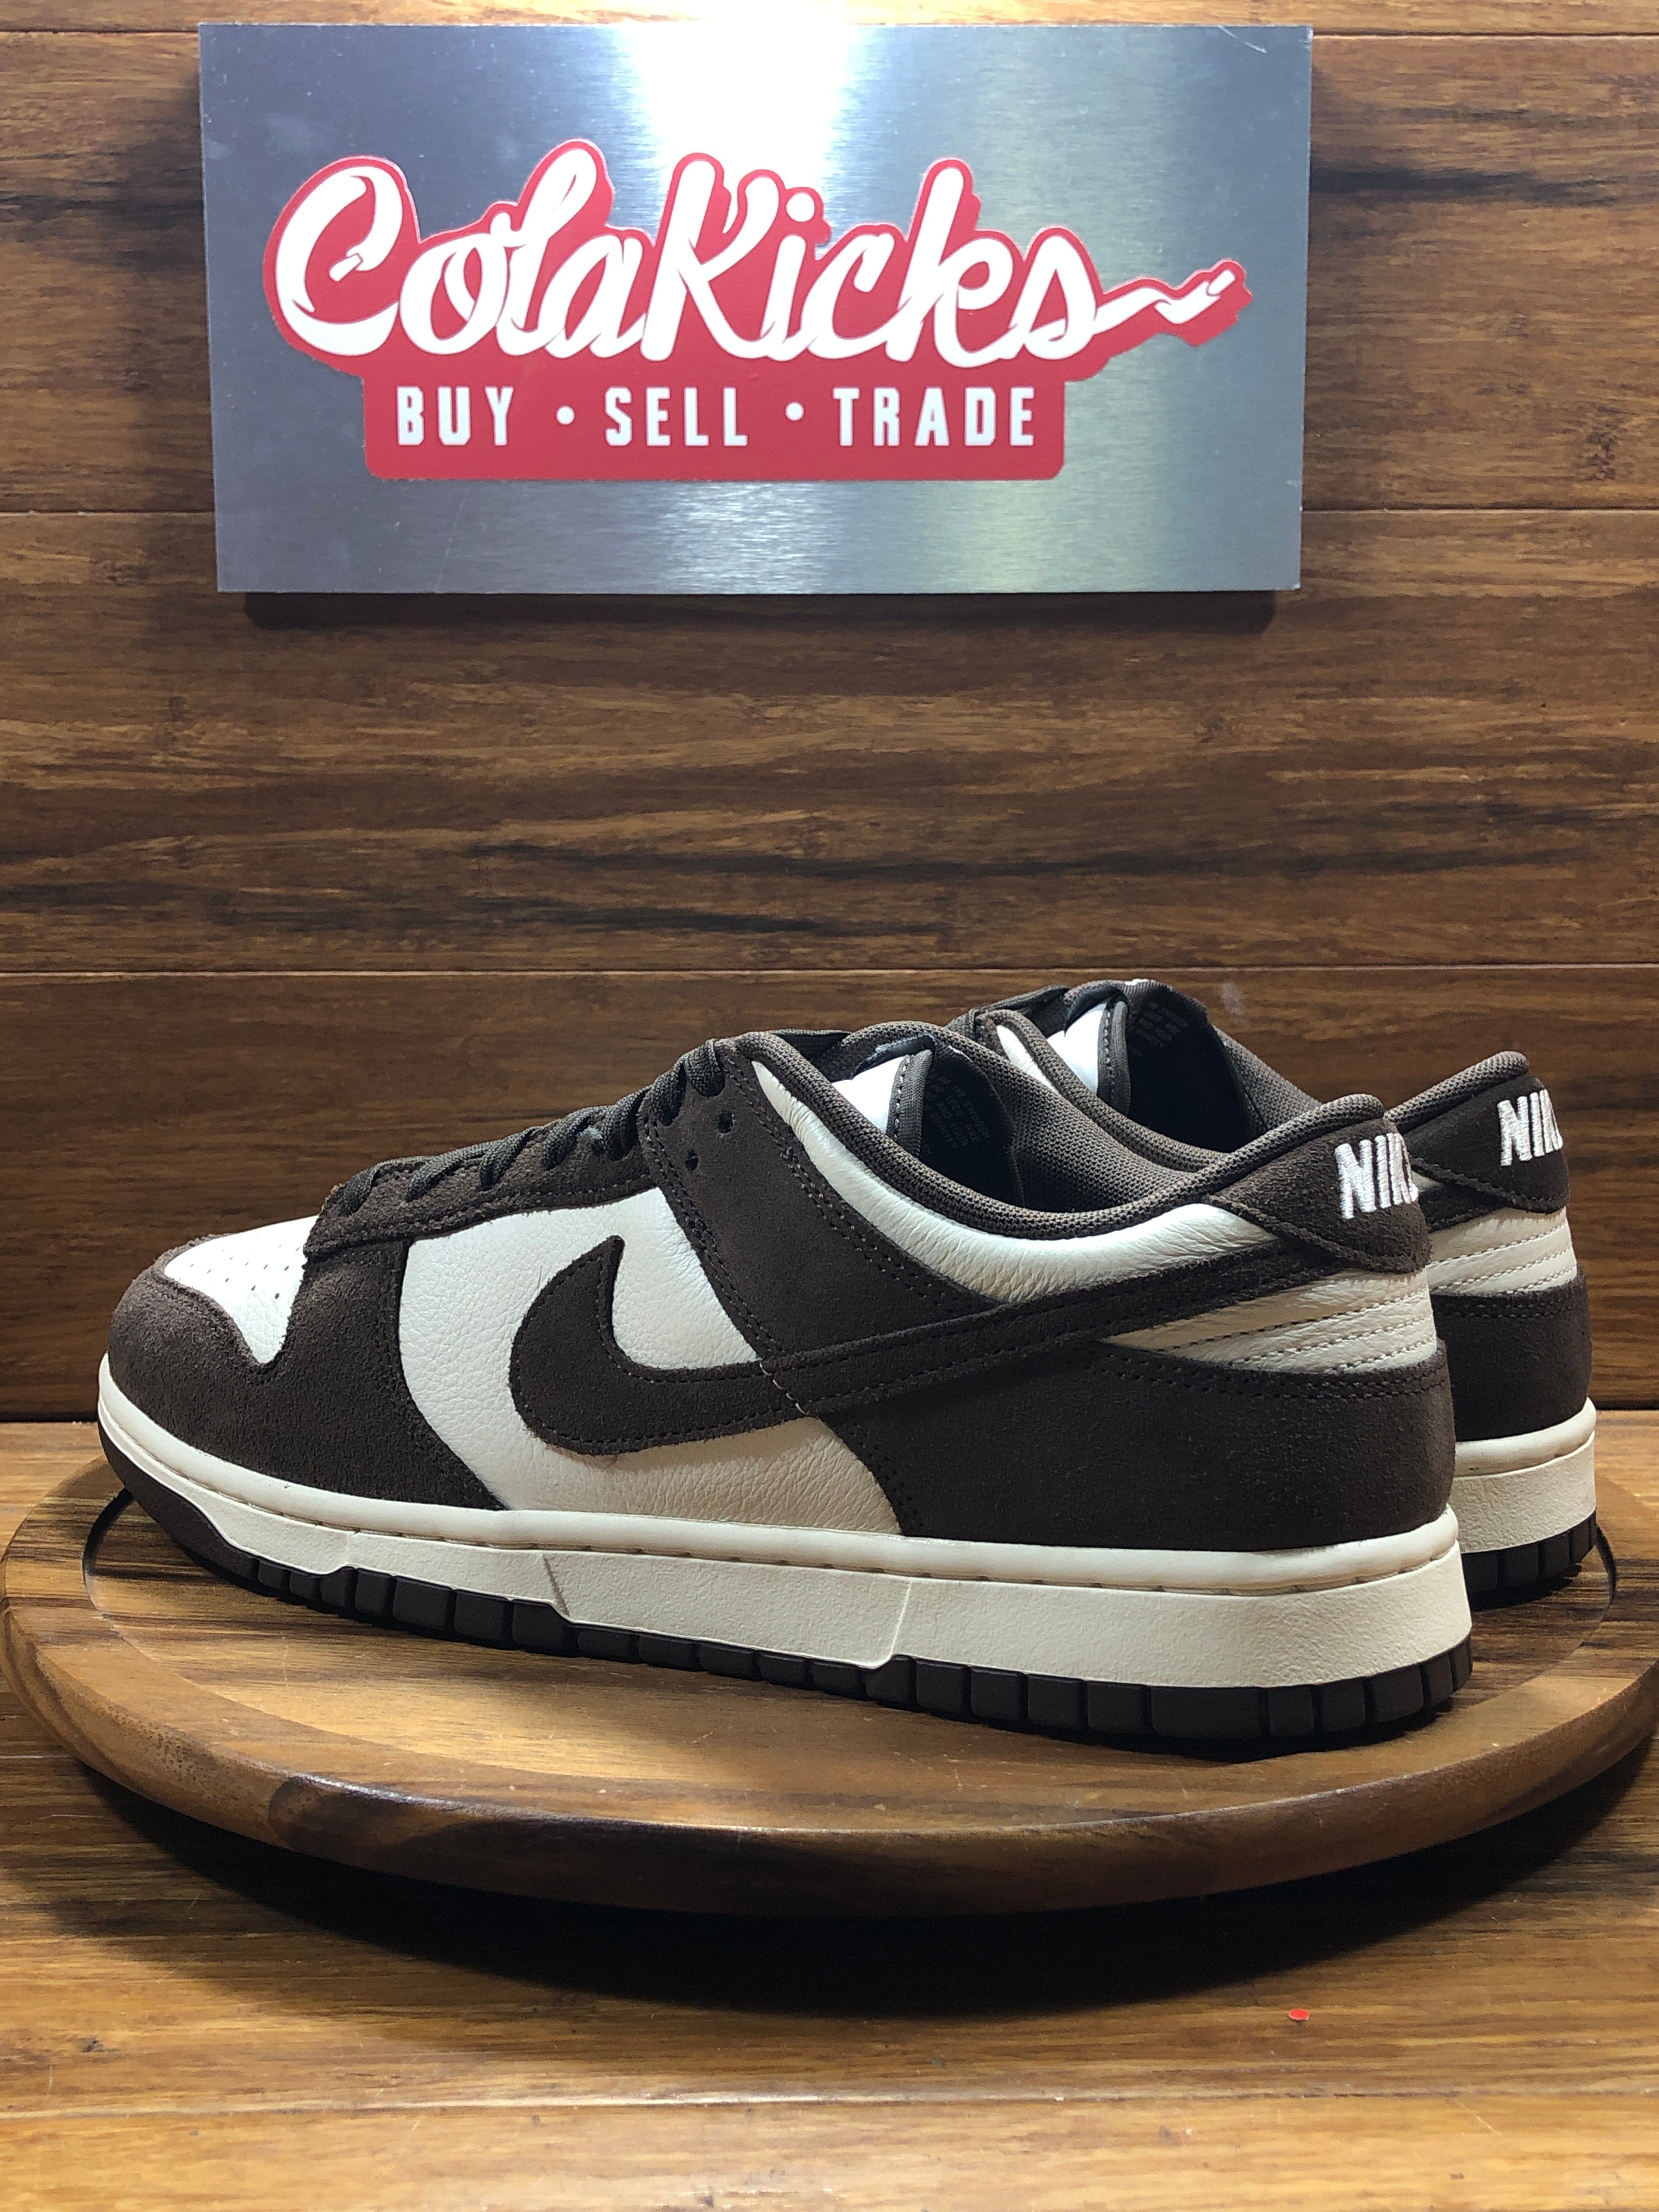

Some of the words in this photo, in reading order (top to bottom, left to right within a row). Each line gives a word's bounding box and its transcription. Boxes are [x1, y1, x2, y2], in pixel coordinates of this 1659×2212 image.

[275, 148, 1235, 368] ColaKicks
[397, 387, 514, 445] BUY
[605, 387, 747, 446] SELL
[833, 387, 1034, 446] TRADE
